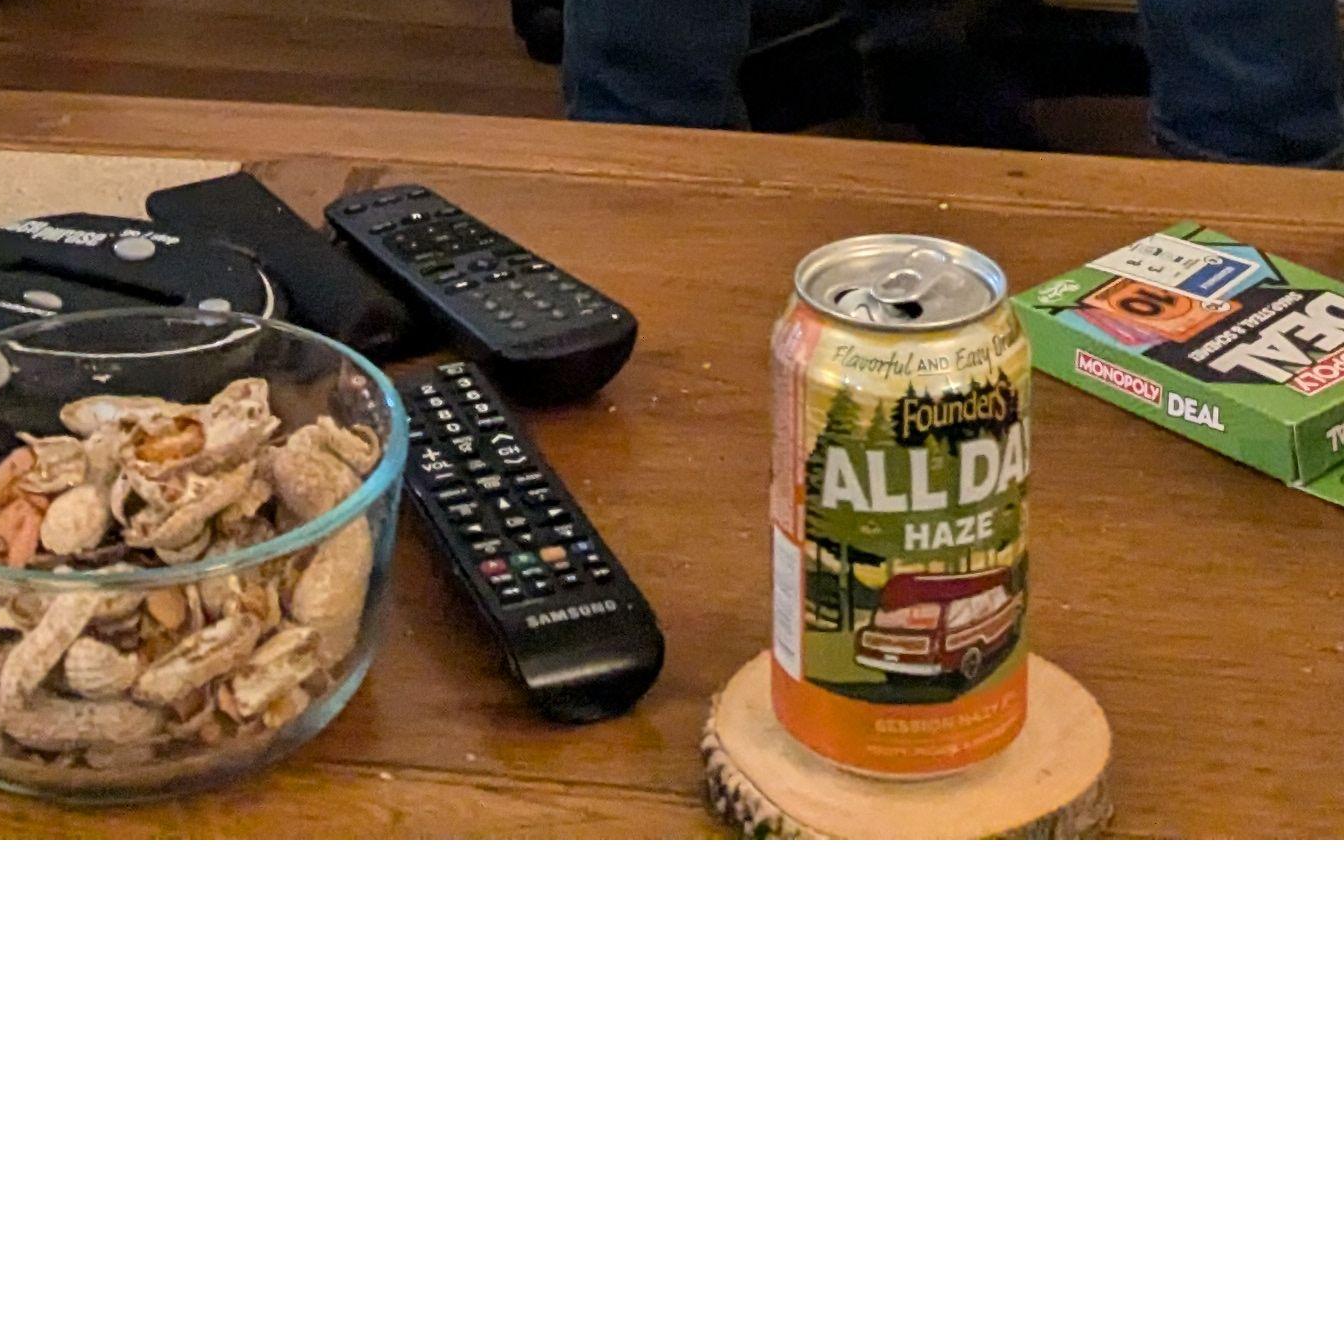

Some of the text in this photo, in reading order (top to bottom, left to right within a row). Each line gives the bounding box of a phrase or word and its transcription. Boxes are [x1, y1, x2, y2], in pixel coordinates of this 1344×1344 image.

[832, 344, 914, 381] Flavorful
[917, 356, 951, 372] AND
[955, 345, 994, 375] Easy
[1079, 354, 1225, 432] MONOPOLY DEAL
[421, 460, 454, 473] VOL
[821, 416, 1031, 512] ALL DA
[904, 511, 994, 551] HAZE
[525, 599, 618, 629] SAMSUNG
